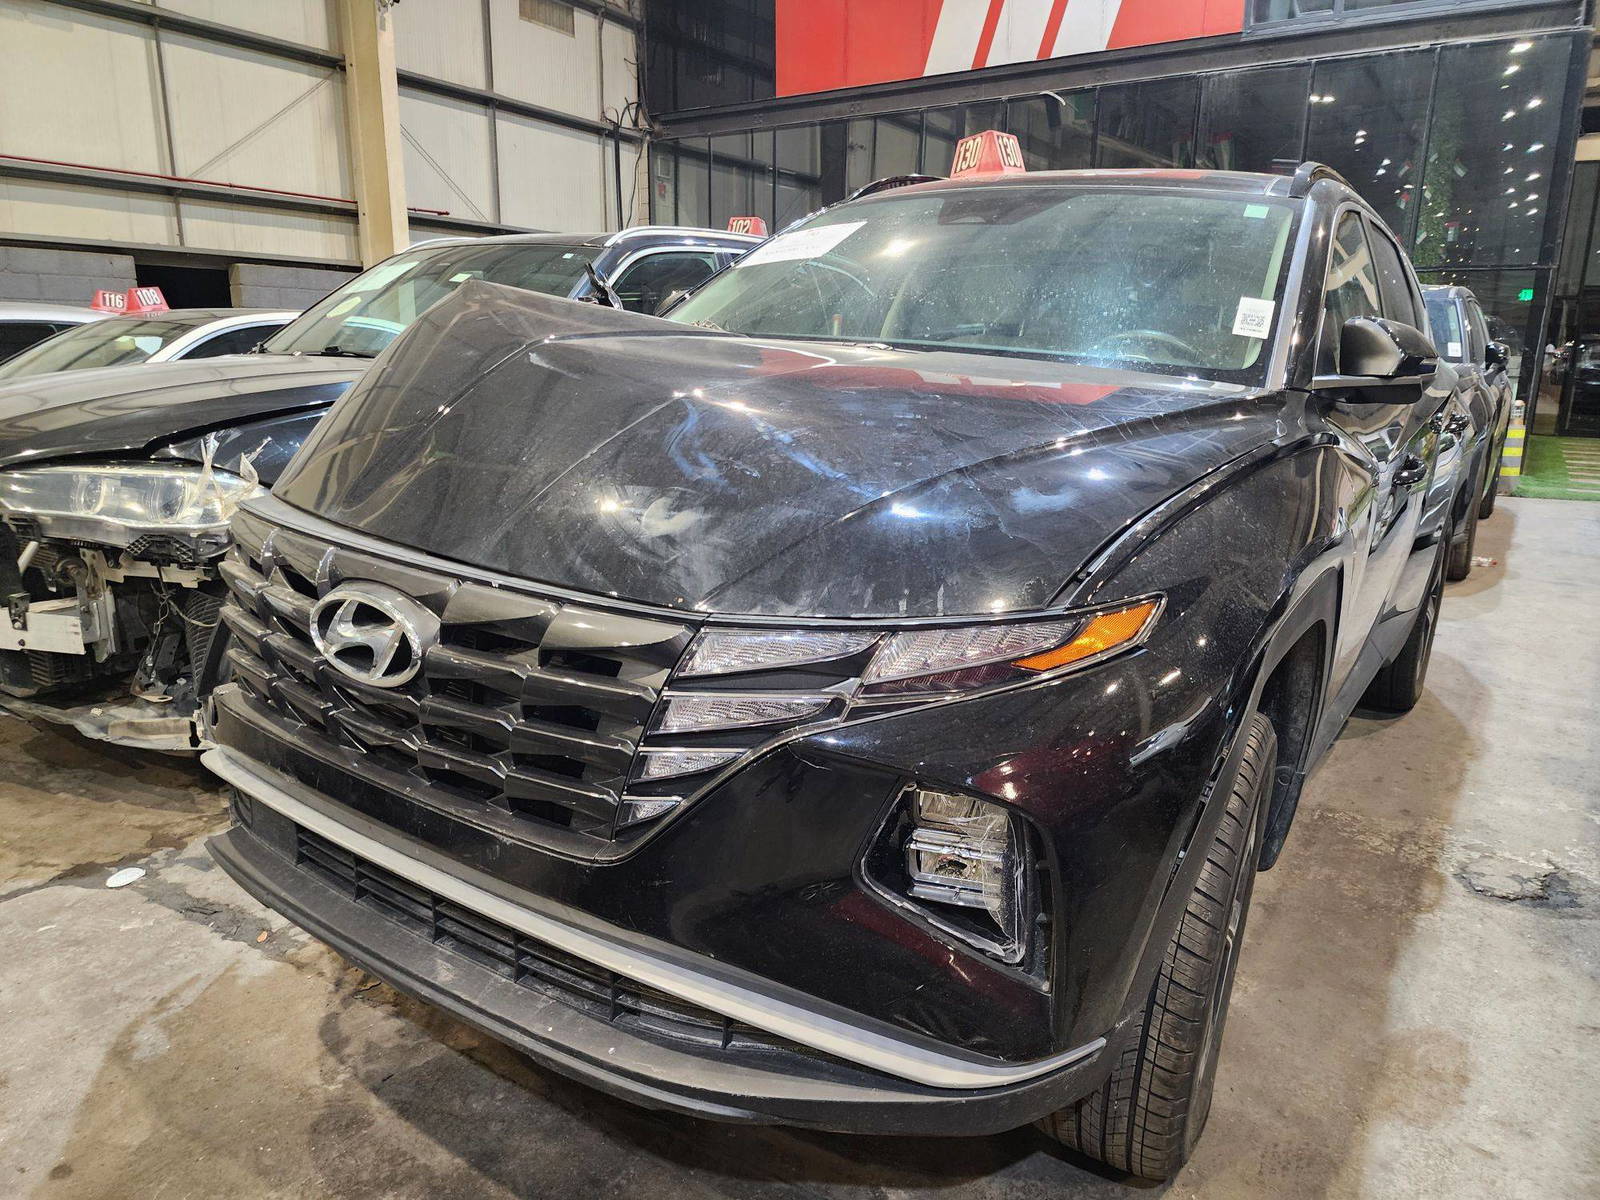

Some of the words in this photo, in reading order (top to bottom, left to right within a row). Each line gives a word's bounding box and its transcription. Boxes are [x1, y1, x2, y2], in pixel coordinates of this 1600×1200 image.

[956, 136, 982, 173] 130
[998, 135, 1021, 168] 130
[732, 219, 750, 234] 102
[103, 292, 124, 308] 116
[136, 288, 161, 306] 108
